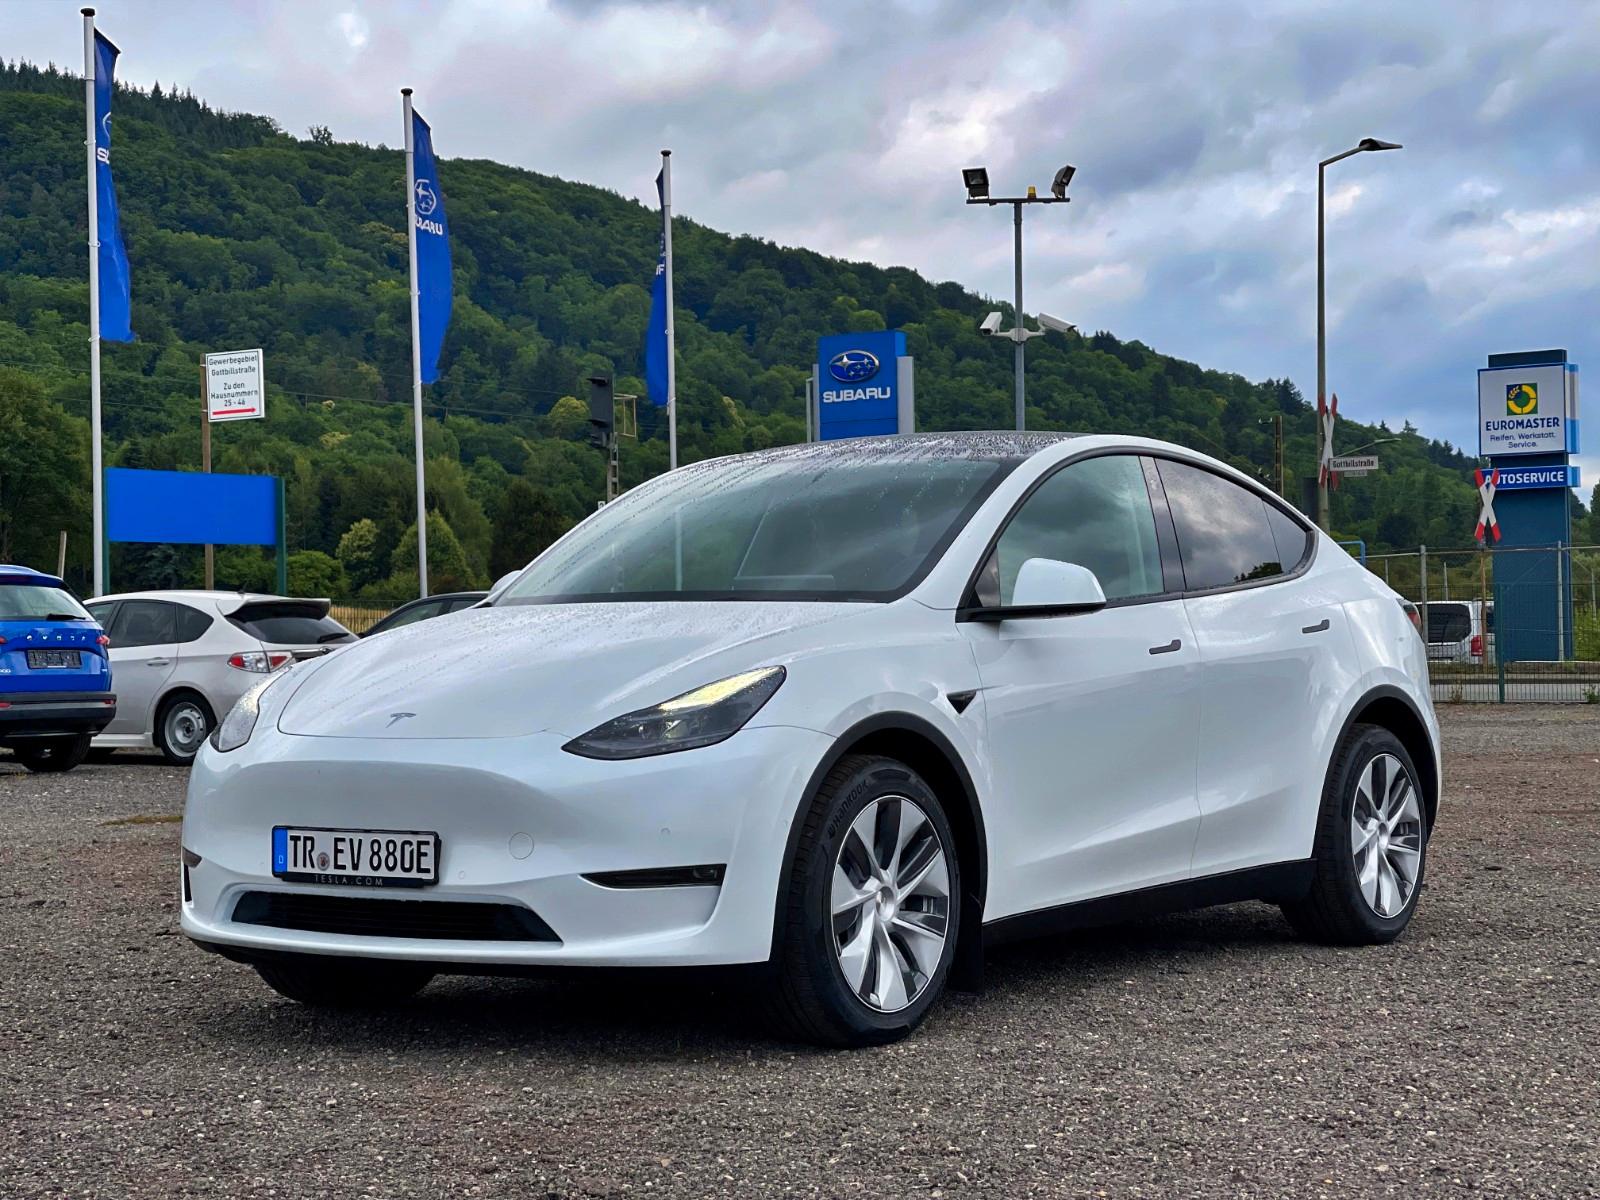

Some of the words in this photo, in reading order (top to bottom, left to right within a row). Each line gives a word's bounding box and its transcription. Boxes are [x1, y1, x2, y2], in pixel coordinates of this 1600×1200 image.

[211, 390, 258, 399] Hausnummern
[822, 386, 891, 403] SUBARU
[1485, 416, 1560, 432] EUROMASTER
[1484, 471, 1564, 484] ATOSERVICE
[278, 855, 284, 864] D
[289, 835, 315, 869] TR
[333, 837, 363, 871] EV
[369, 839, 431, 874] 880E
[314, 875, 384, 886] TESLA.COM
